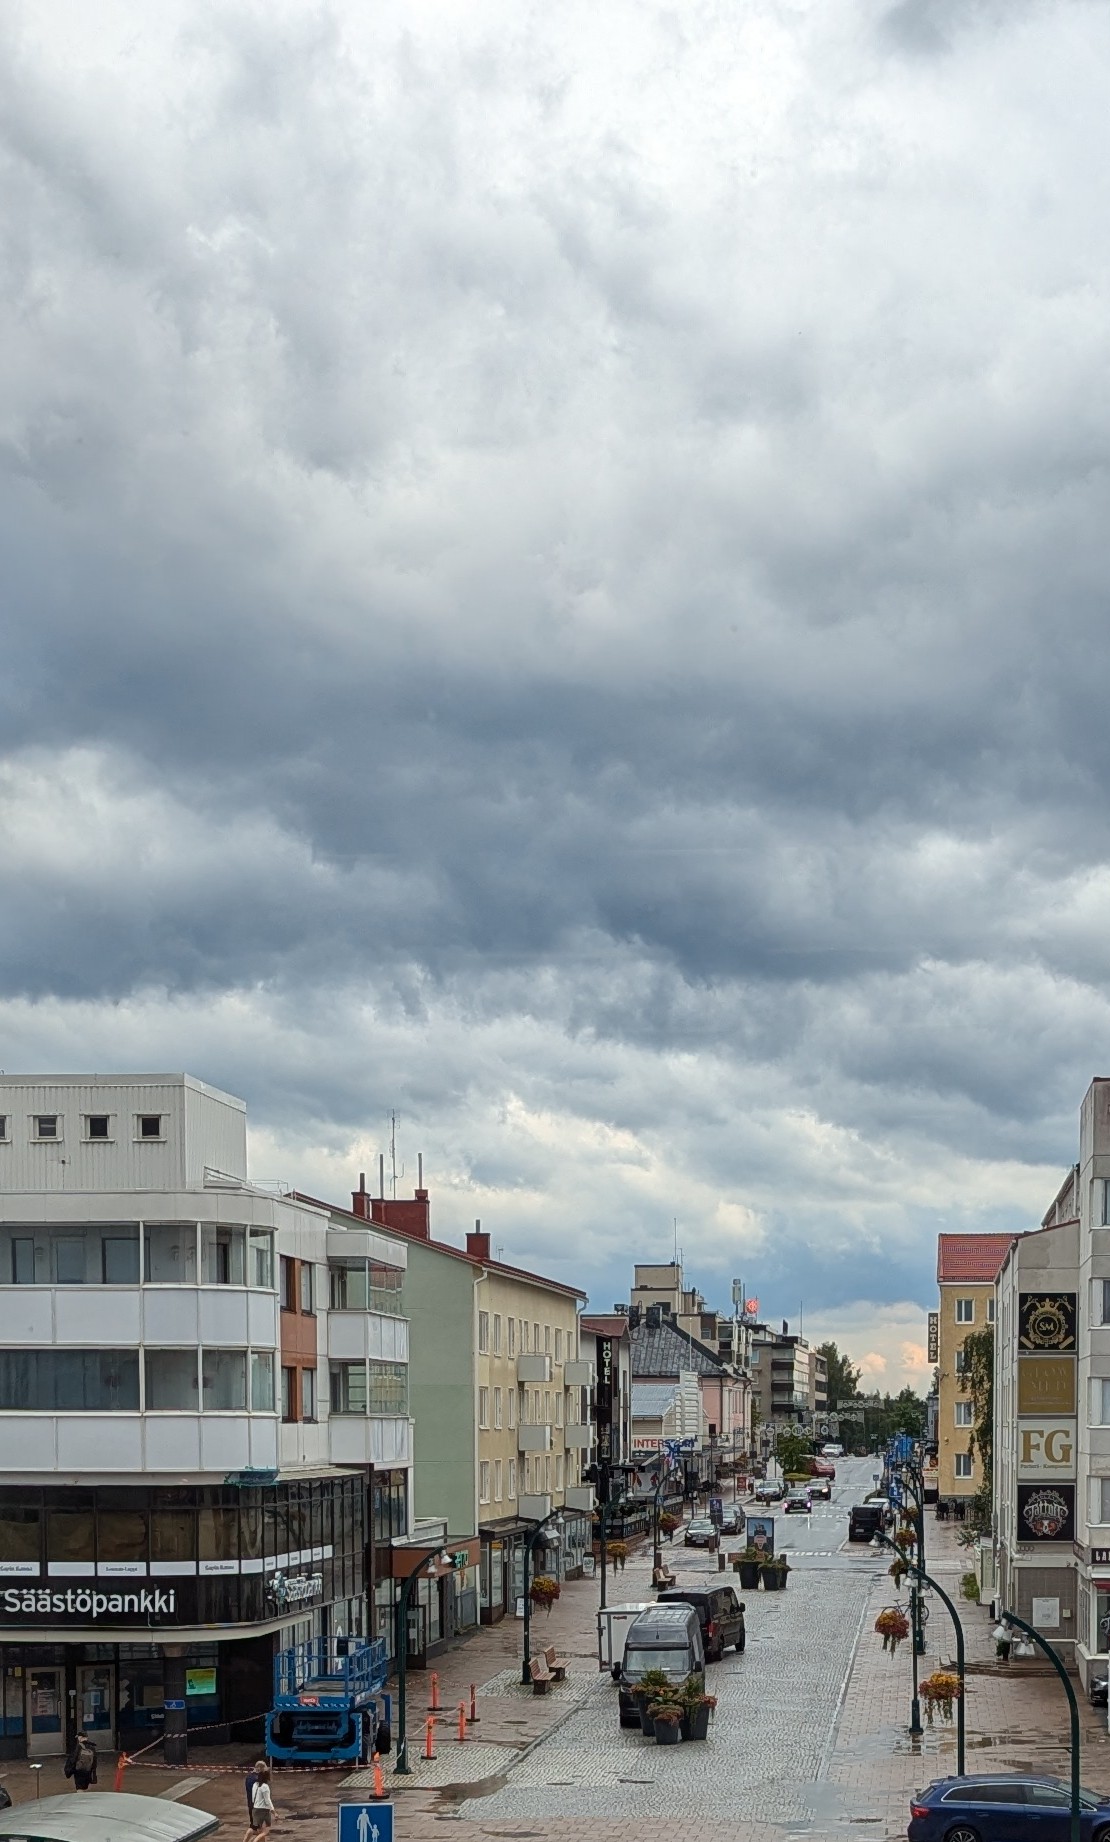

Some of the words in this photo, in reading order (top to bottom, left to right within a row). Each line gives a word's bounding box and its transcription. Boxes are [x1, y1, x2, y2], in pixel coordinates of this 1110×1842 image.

[929, 1316, 938, 1360] HOTEL
[602, 1341, 612, 1385] HOTEL
[1020, 1429, 1073, 1463] FG
[4, 1588, 175, 1618] Säästöpankki
